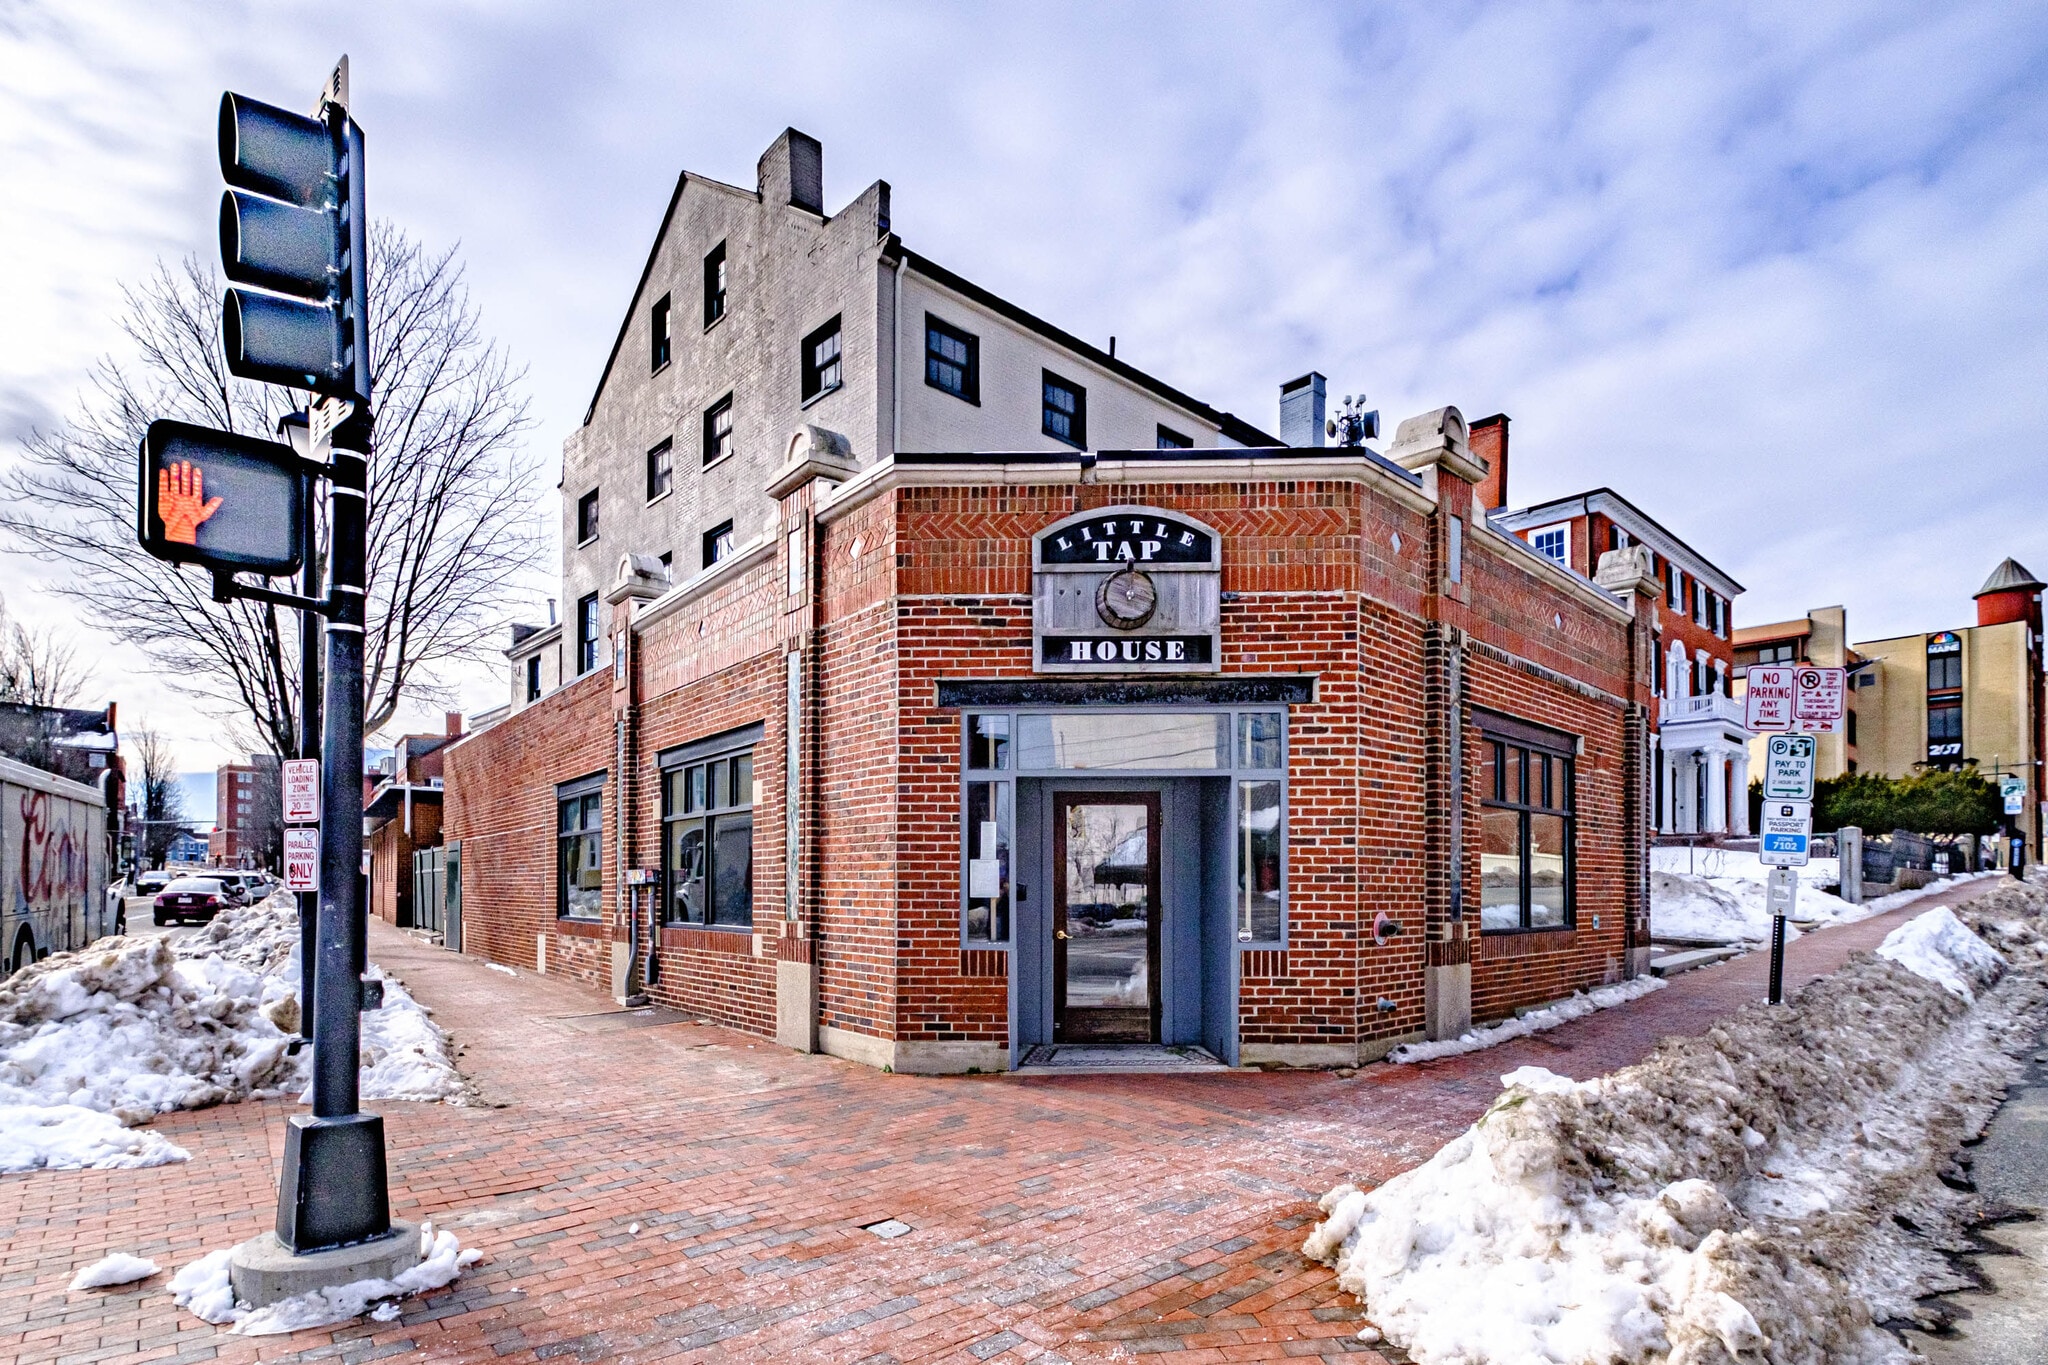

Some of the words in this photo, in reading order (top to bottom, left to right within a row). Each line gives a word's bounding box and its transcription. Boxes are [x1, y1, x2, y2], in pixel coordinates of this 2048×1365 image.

[1056, 520, 1195, 551] LITTLE
[1093, 540, 1162, 561] TAP
[1069, 641, 1185, 661] HOUSE
[1928, 643, 1960, 654] MAINE
[1762, 672, 1780, 685] NO
[1750, 686, 1791, 699] PARKING
[1760, 700, 1779, 708] ANY
[1759, 709, 1781, 718] TIME
[1775, 760, 1791, 768] PAY
[1795, 761, 1806, 769] TO
[288, 765, 314, 774] VEHICLE
[1778, 769, 1801, 777] PARK
[288, 775, 314, 784] LOADING
[292, 784, 310, 793] ZONE
[291, 801, 302, 810] 30
[288, 840, 313, 849] PARALLEL
[1773, 841, 1798, 851] 7102
[288, 852, 315, 861] PARKING
[289, 862, 314, 879] ONLY
